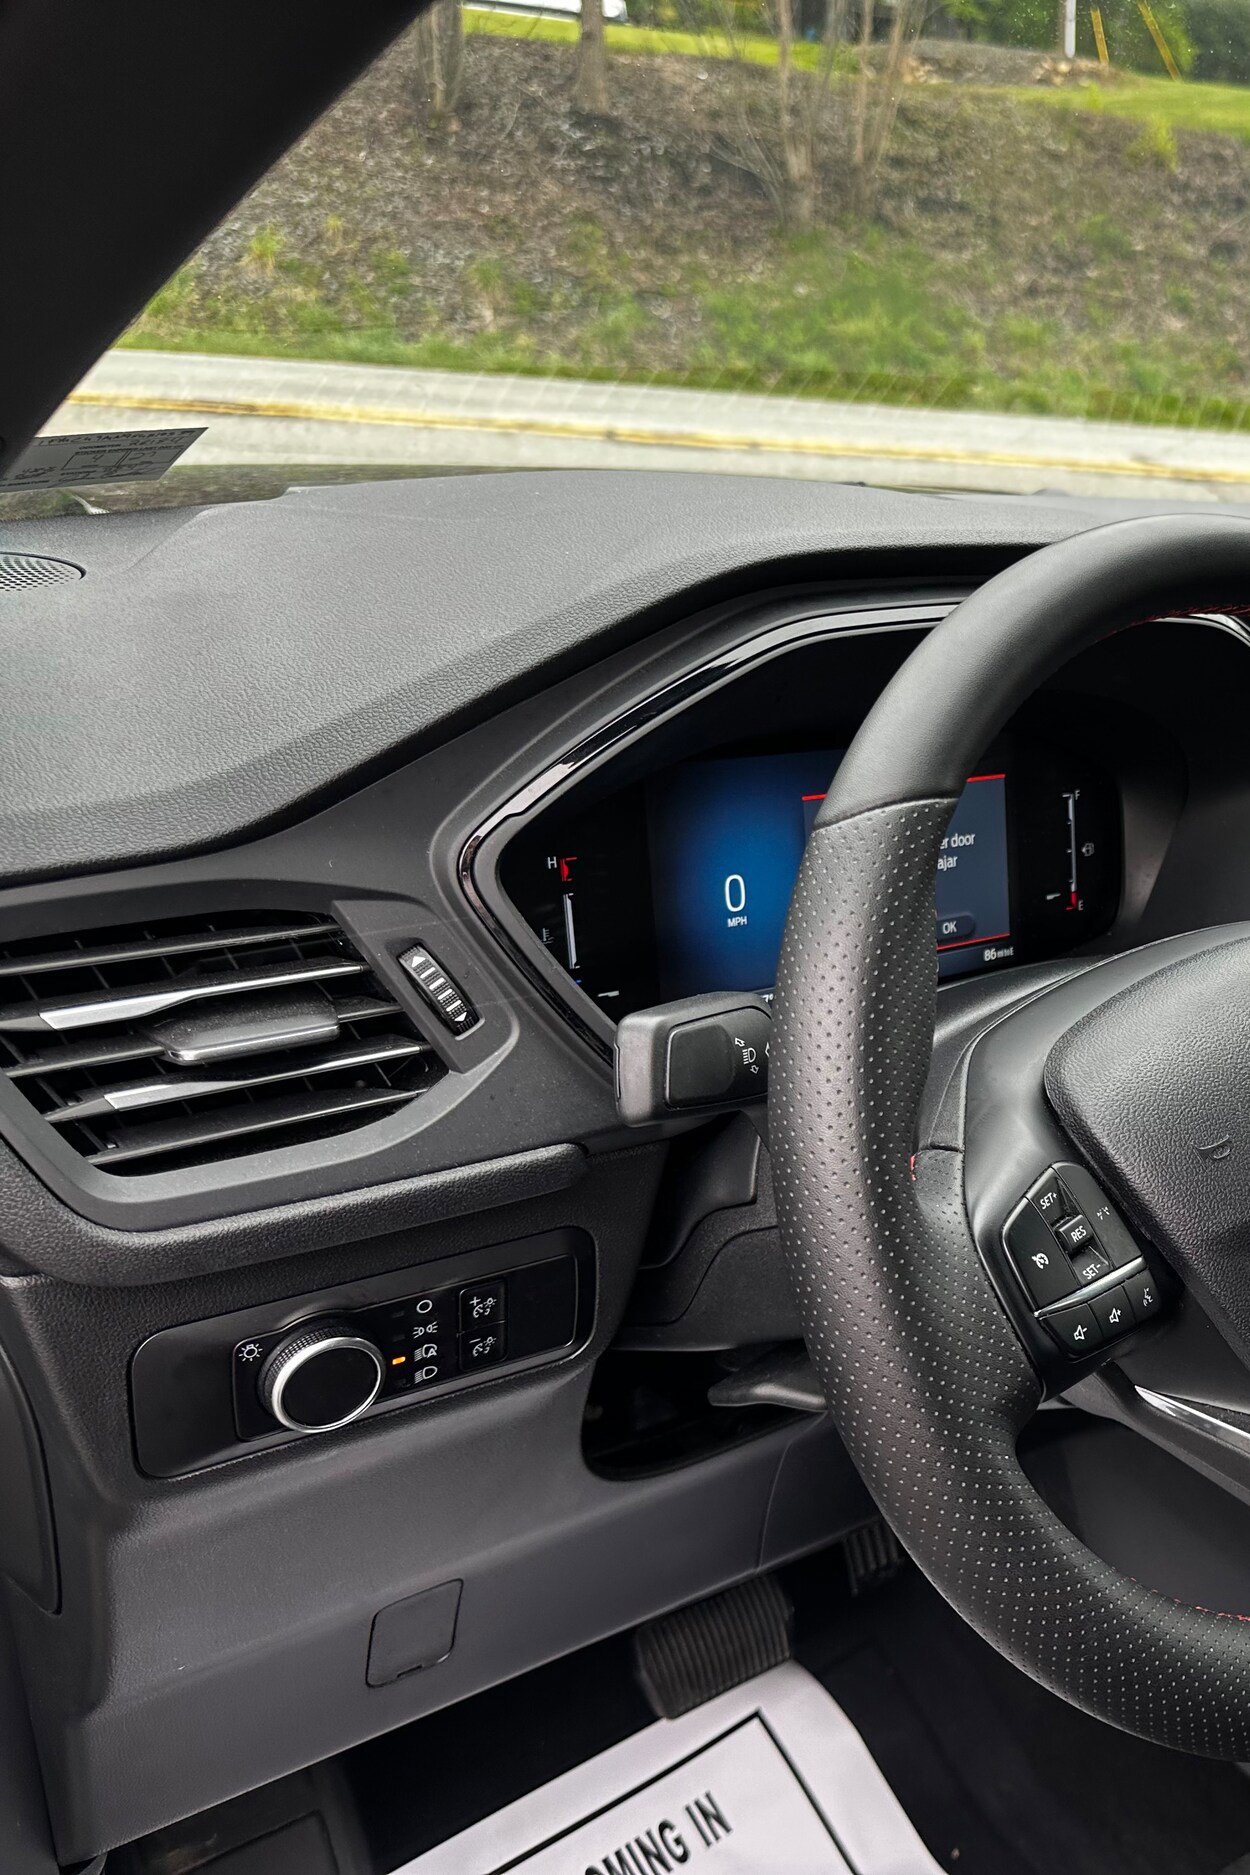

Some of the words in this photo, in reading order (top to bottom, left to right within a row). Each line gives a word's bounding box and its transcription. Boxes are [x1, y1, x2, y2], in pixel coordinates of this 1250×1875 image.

[951, 833, 975, 848] door
[547, 856, 557, 869] H
[937, 855, 958, 871] ajar
[724, 874, 747, 913] 0
[727, 915, 748, 928] MPH
[942, 921, 957, 935] OK
[984, 948, 996, 961] 86
[1039, 1191, 1058, 1210] SET+
[1070, 1225, 1087, 1242] RES
[684, 1790, 734, 1848] IN
